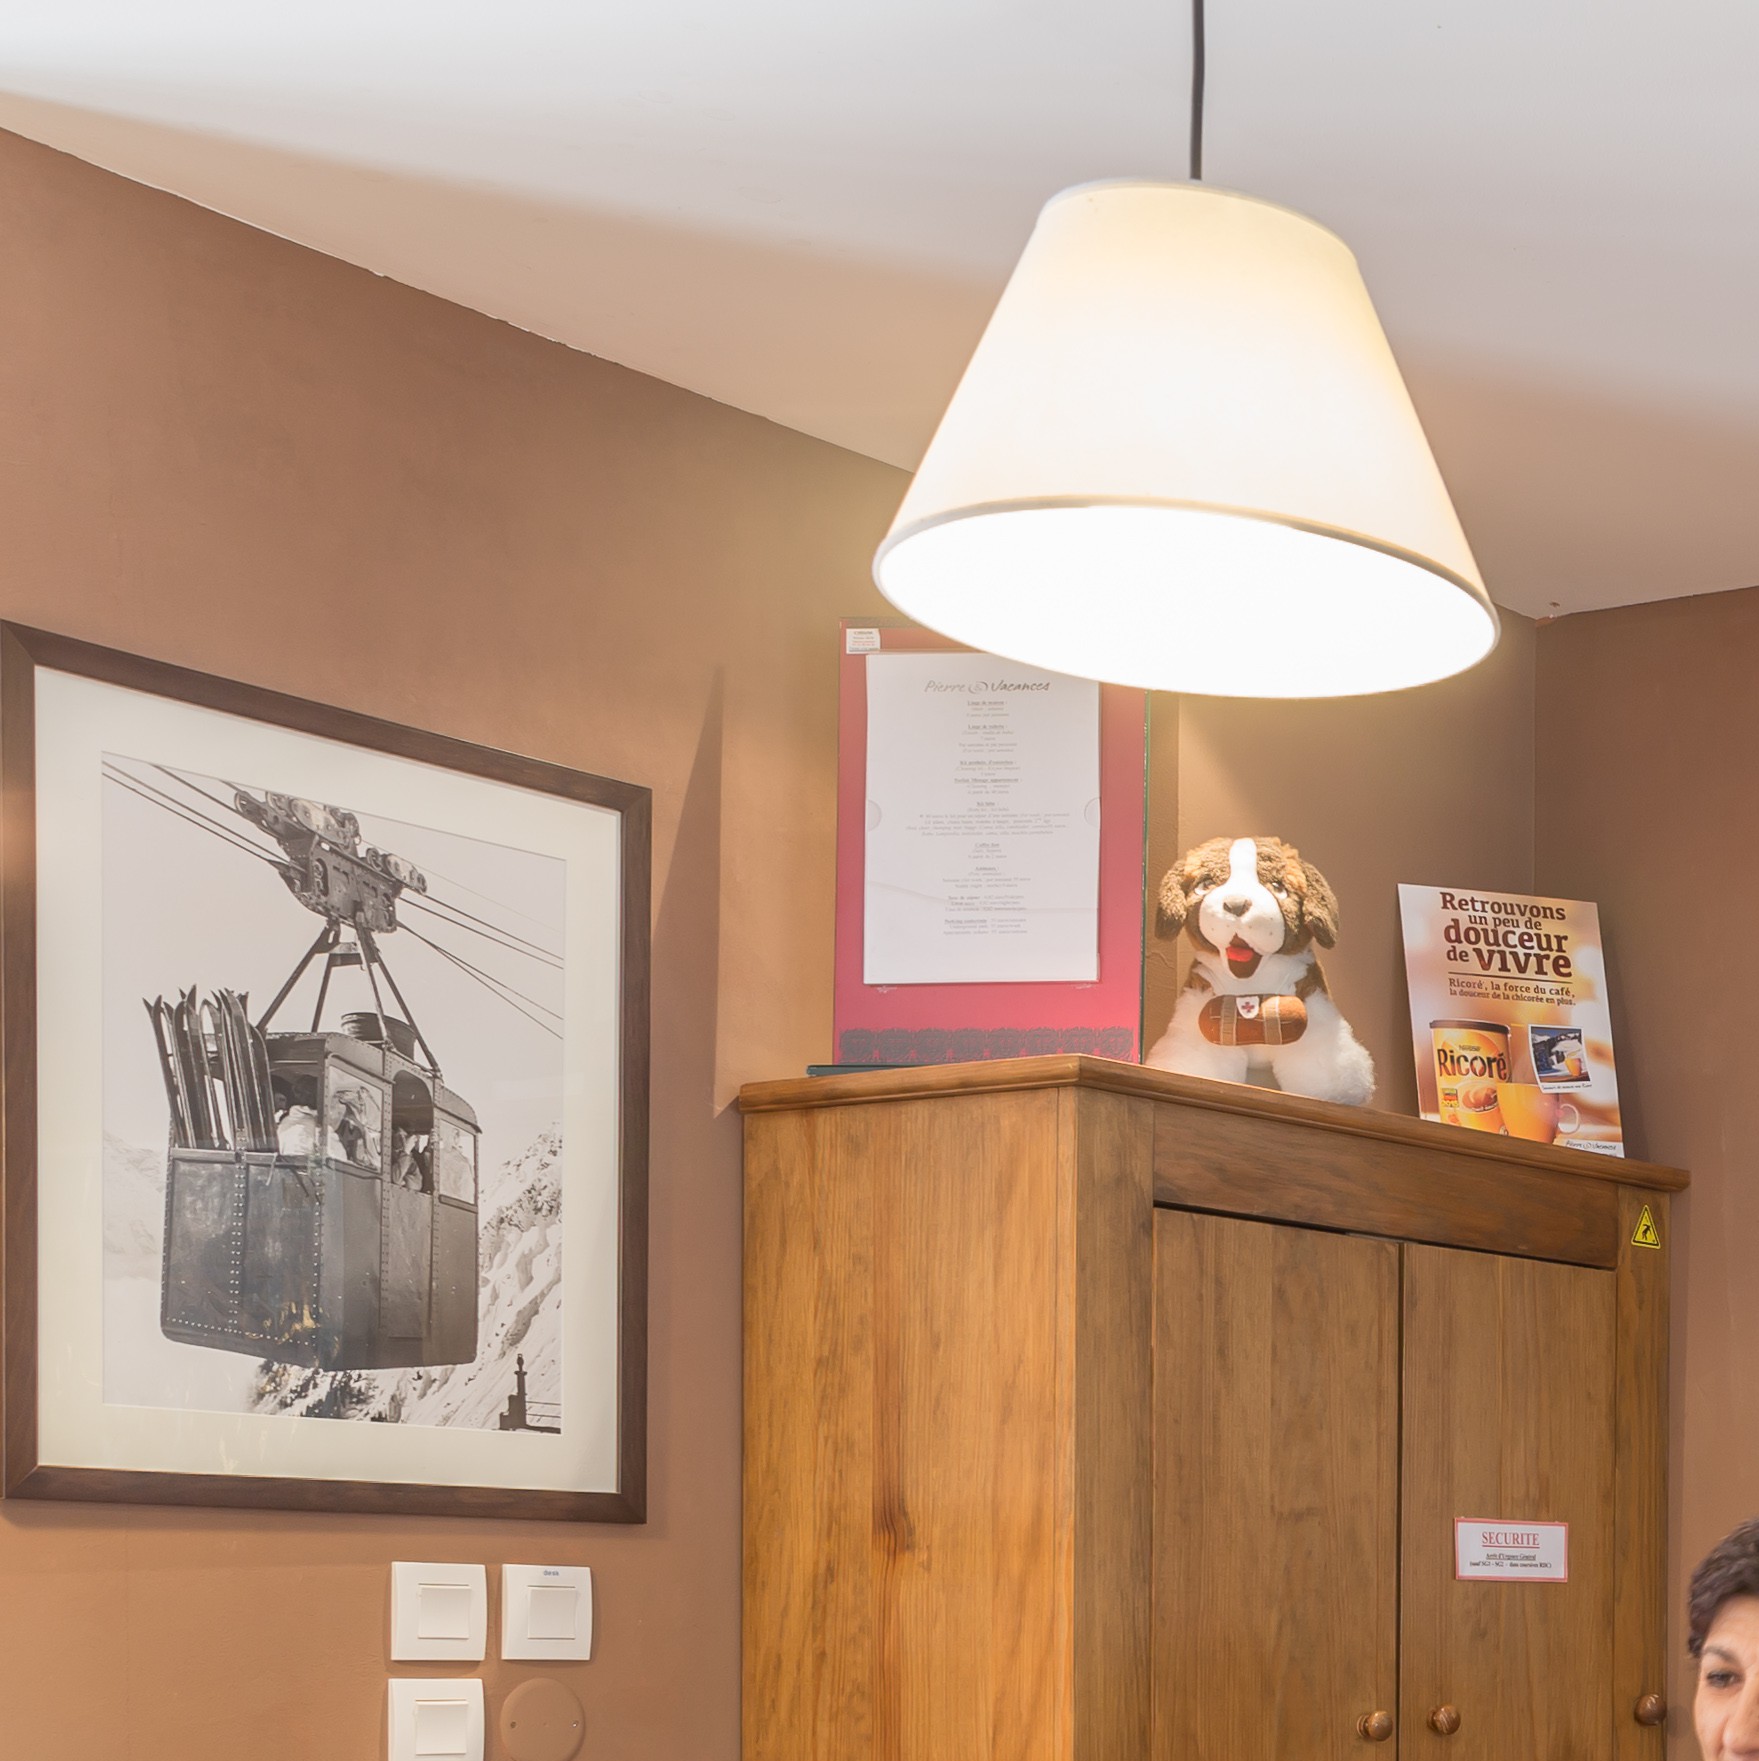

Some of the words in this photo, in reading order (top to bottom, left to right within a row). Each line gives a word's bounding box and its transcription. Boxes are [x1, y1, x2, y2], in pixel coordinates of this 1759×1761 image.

[924, 680, 966, 693] Pierre
[991, 680, 1051, 692] Vacances
[1440, 892, 1566, 921] Retrouvons
[1468, 914, 1488, 926] un
[1493, 917, 1520, 930] peu
[1525, 917, 1542, 931] de
[1444, 918, 1568, 953] douceur
[1446, 945, 1469, 963] de
[1472, 947, 1572, 978] vivre
[1450, 987, 1457, 996] la
[1459, 988, 1490, 999] douceur
[1492, 991, 1500, 999] de
[1502, 991, 1510, 1000] la
[1512, 993, 1544, 1003] chicorée
[1546, 996, 1556, 1004] en
[1490, 979, 1500, 991] la
[1504, 981, 1531, 994] force
[1534, 983, 1546, 995] du
[1550, 984, 1576, 998] café,
[1438, 1048, 1508, 1081] Ricoré
[1482, 1531, 1540, 1546] SECURITE
